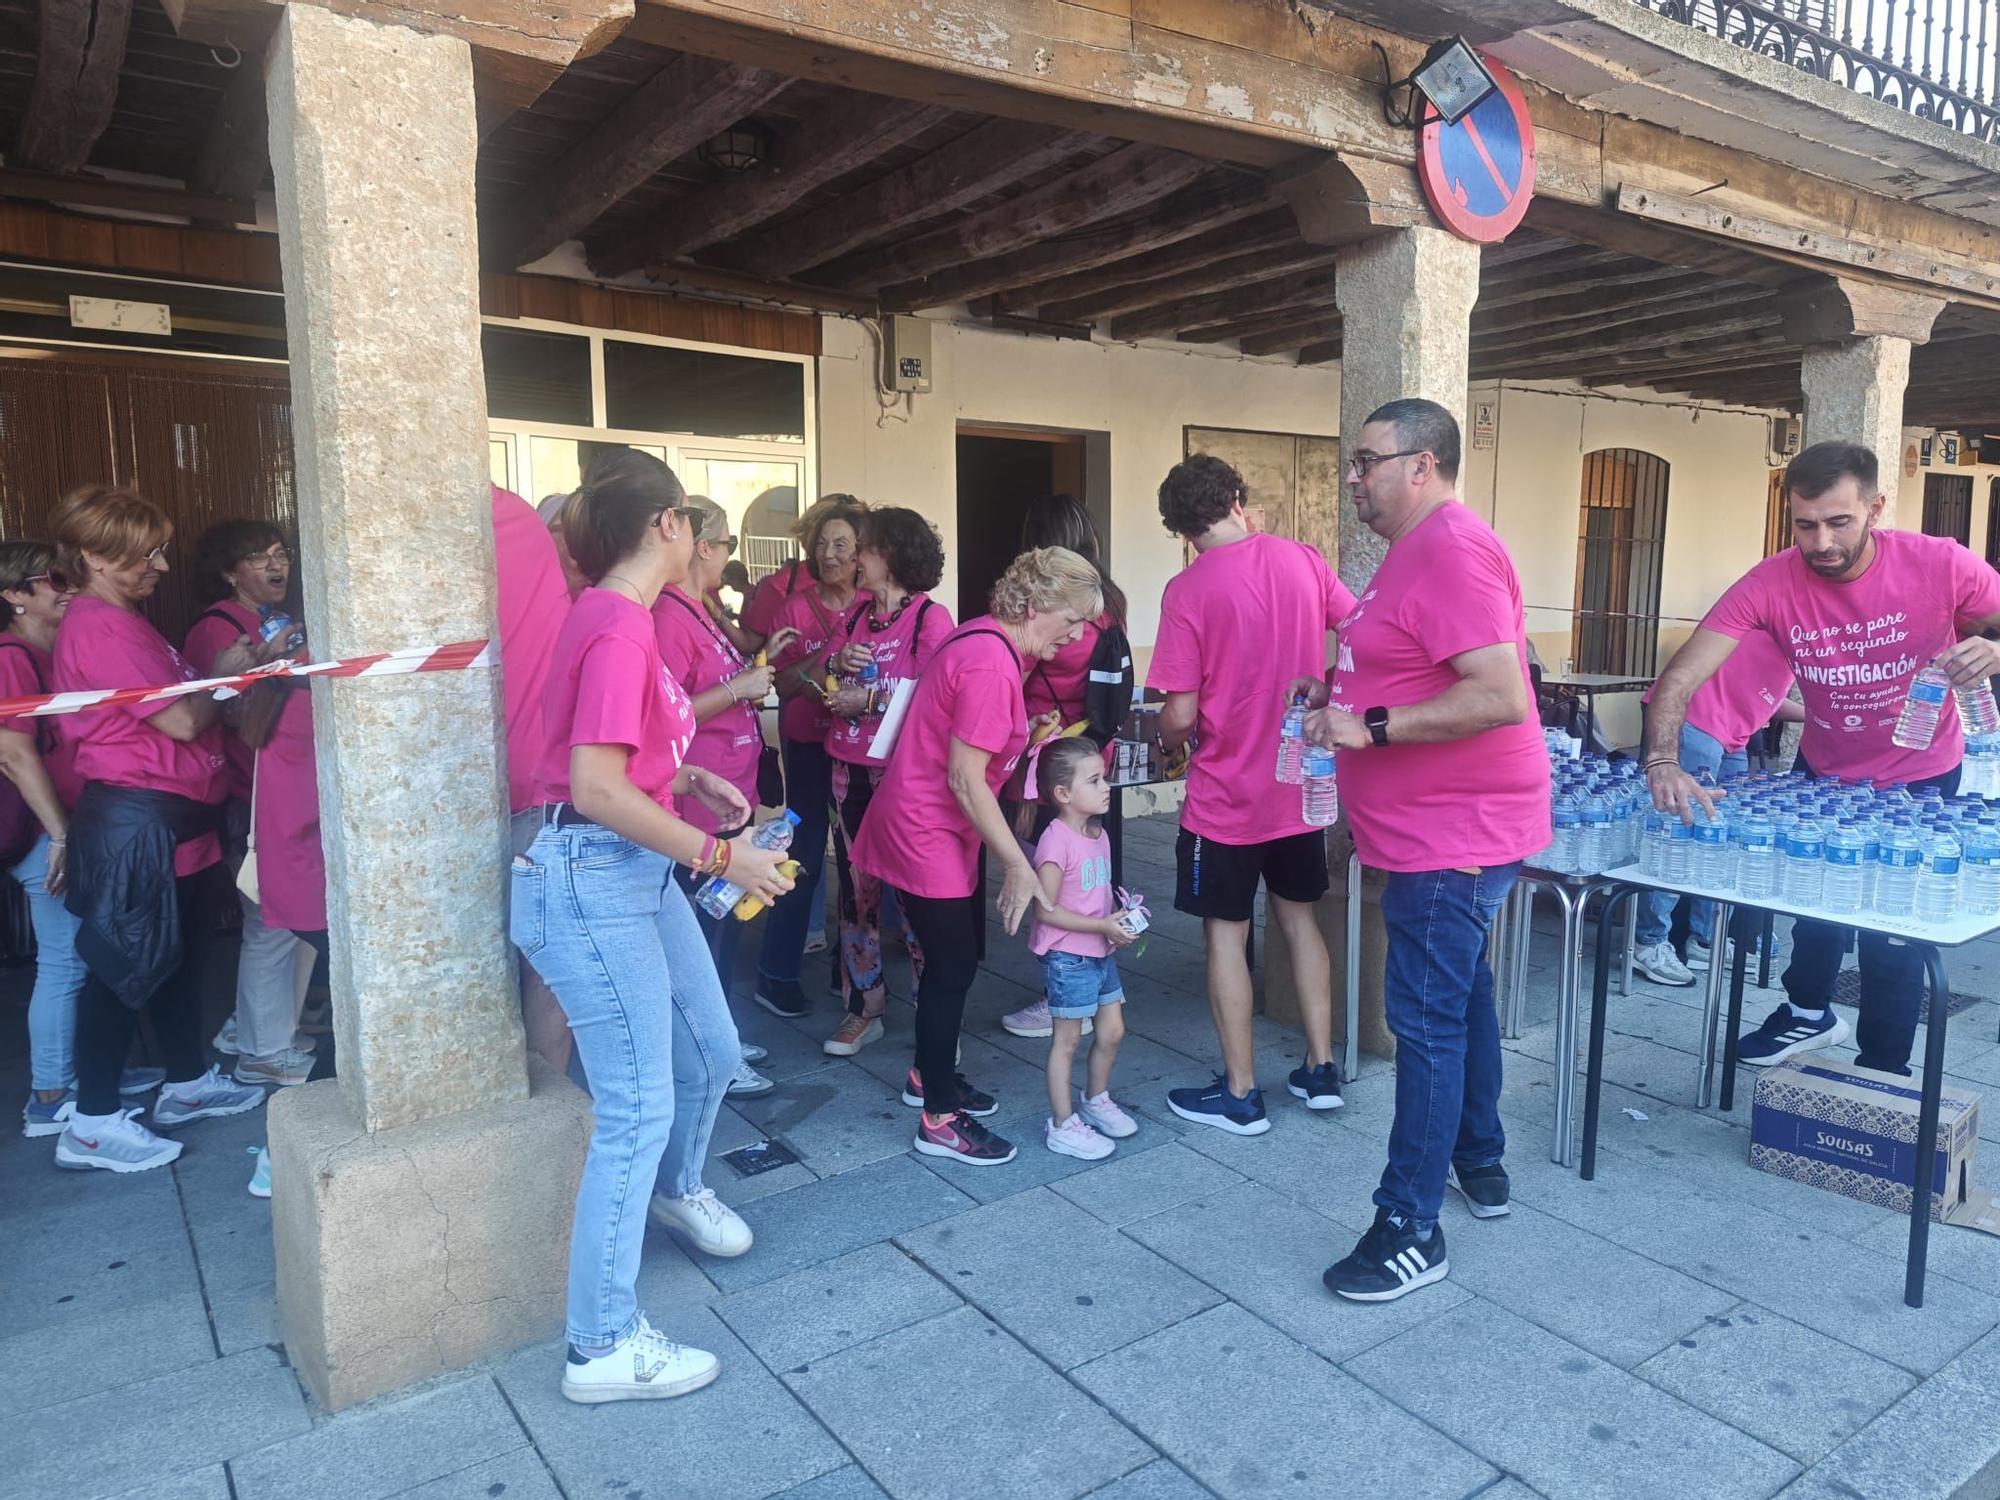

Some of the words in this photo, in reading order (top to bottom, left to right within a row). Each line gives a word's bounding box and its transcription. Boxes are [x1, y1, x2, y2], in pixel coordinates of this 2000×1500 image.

[1791, 625, 1820, 644] Que
[1823, 626, 1841, 639] no
[1845, 622, 1863, 635] se
[1867, 611, 1907, 639] pare
[1795, 643, 1813, 657] ni
[1815, 646, 1836, 658] un
[1840, 627, 1909, 658] segundo
[1803, 653, 1918, 687] INVESTIGACIÓN
[1829, 691, 1850, 700] Con
[1854, 692, 1866, 700] tu
[1869, 684, 1901, 701] ayuda
[1830, 700, 1840, 709] lo
[1843, 694, 1906, 711] conseguirem
[1082, 855, 1111, 892] GA
[1844, 1075, 1890, 1091] SOUSAS
[1816, 1131, 1874, 1157] SOUSAS
